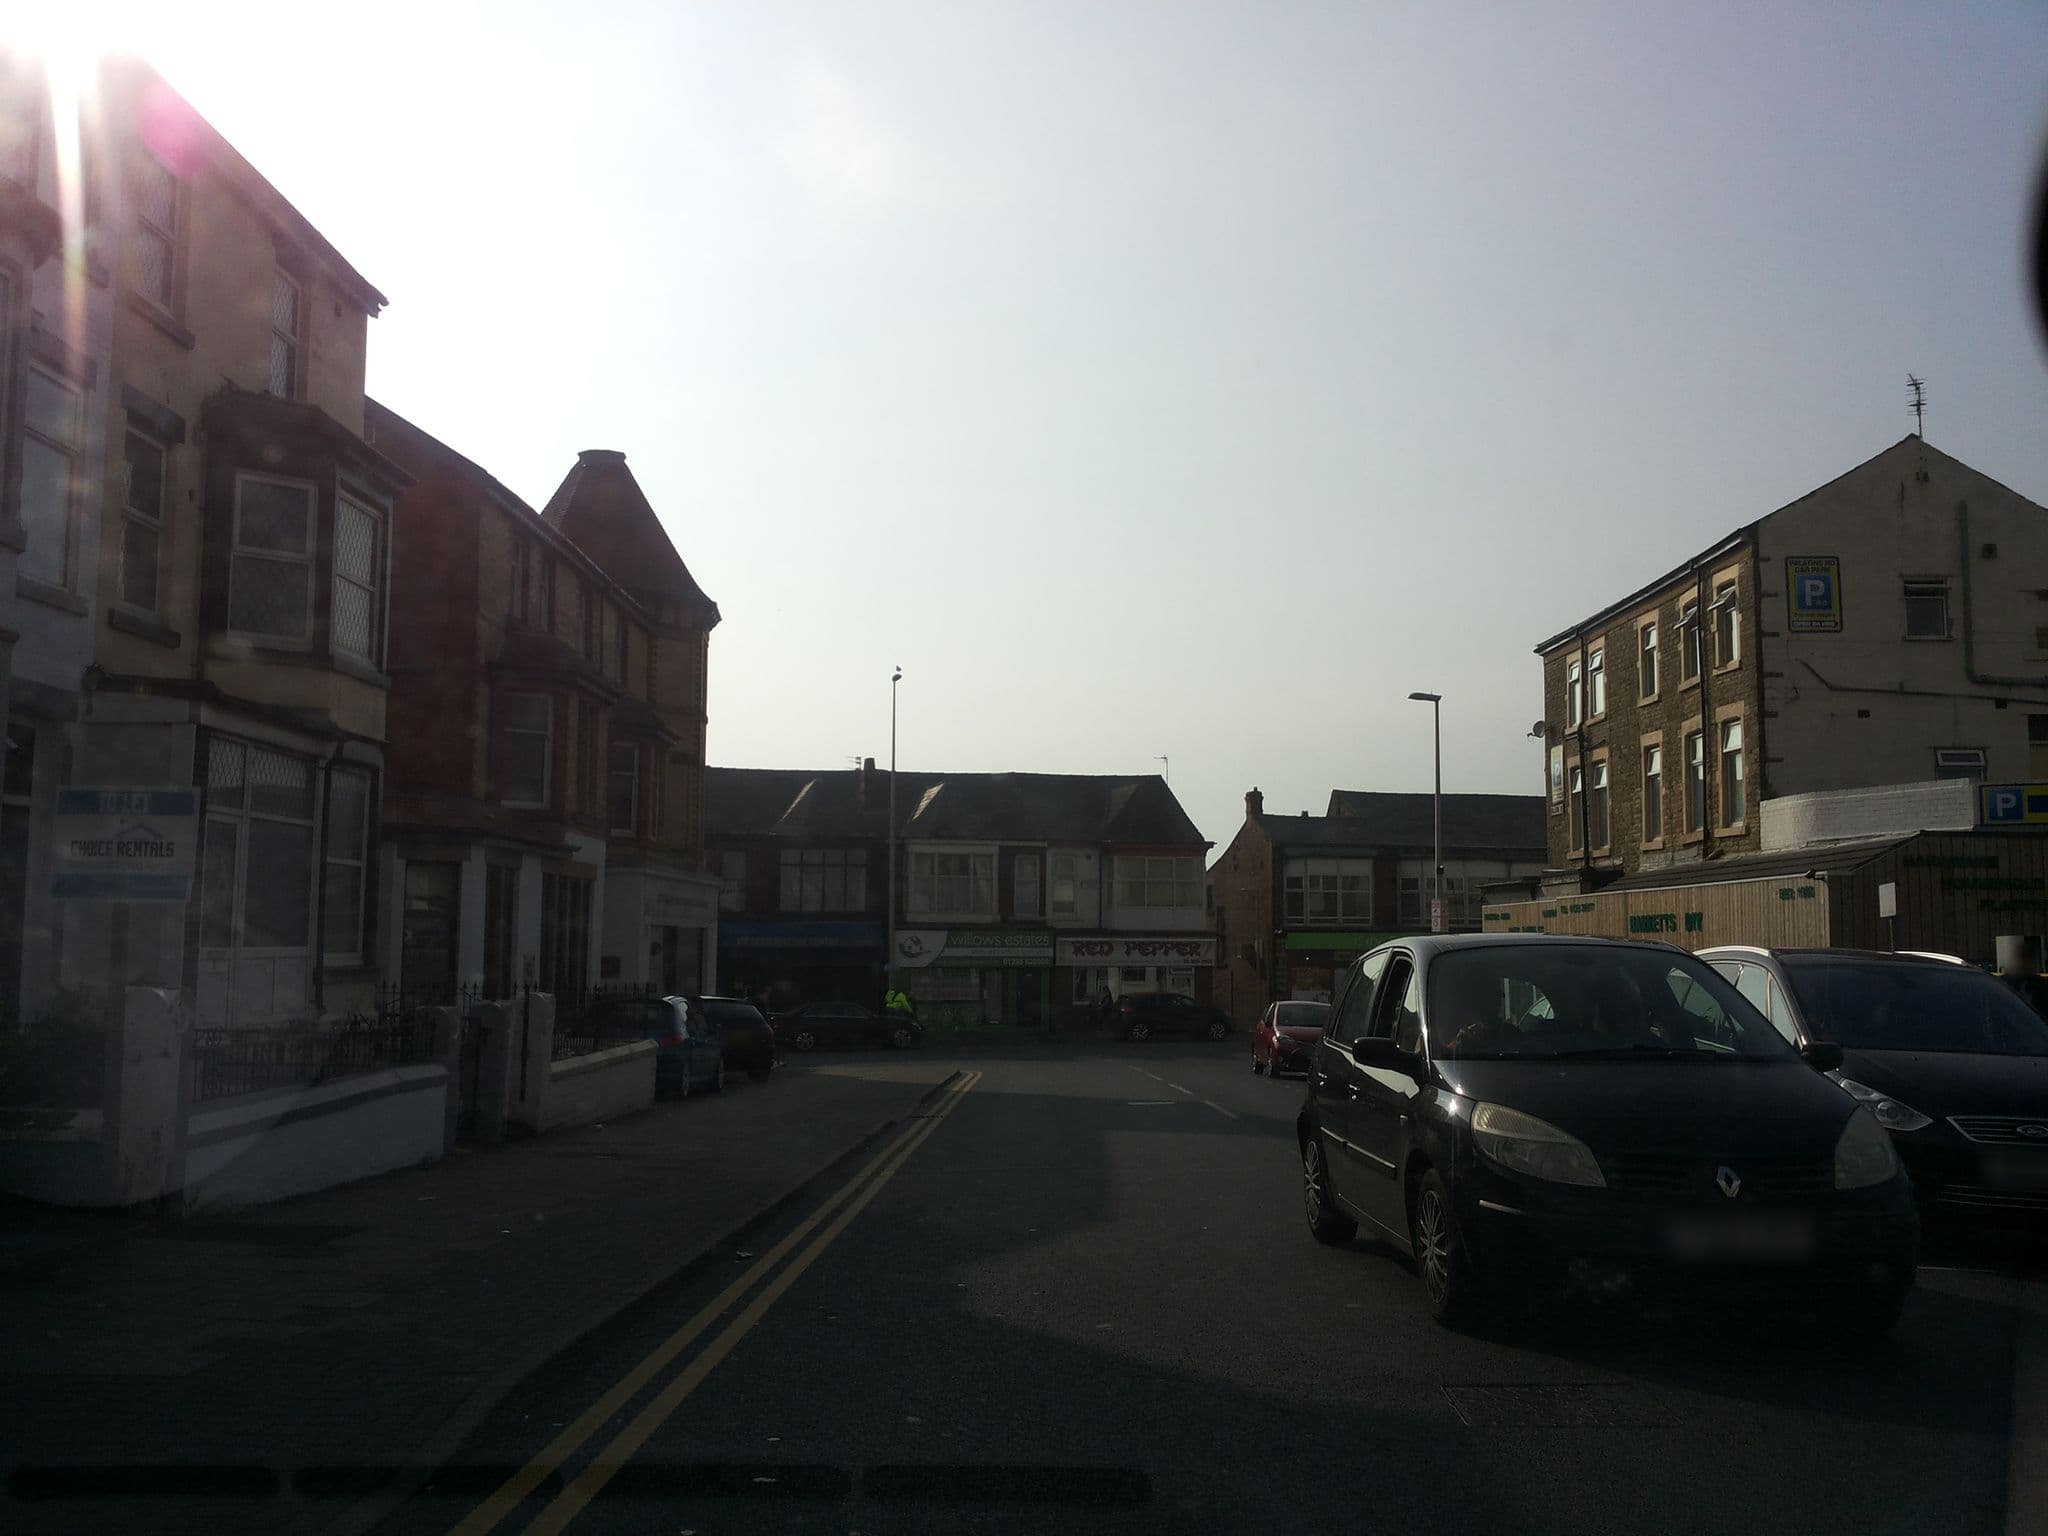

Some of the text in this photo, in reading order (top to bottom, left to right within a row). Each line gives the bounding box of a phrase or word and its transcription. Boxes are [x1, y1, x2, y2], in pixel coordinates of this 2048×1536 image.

[1804, 579, 1825, 606] P
[1996, 792, 2017, 817] P
[70, 839, 175, 857] CHOICE RENTALS
[950, 932, 1049, 946] willows estates
[1072, 941, 1114, 957] RED
[1124, 941, 1201, 957] PEPPER
